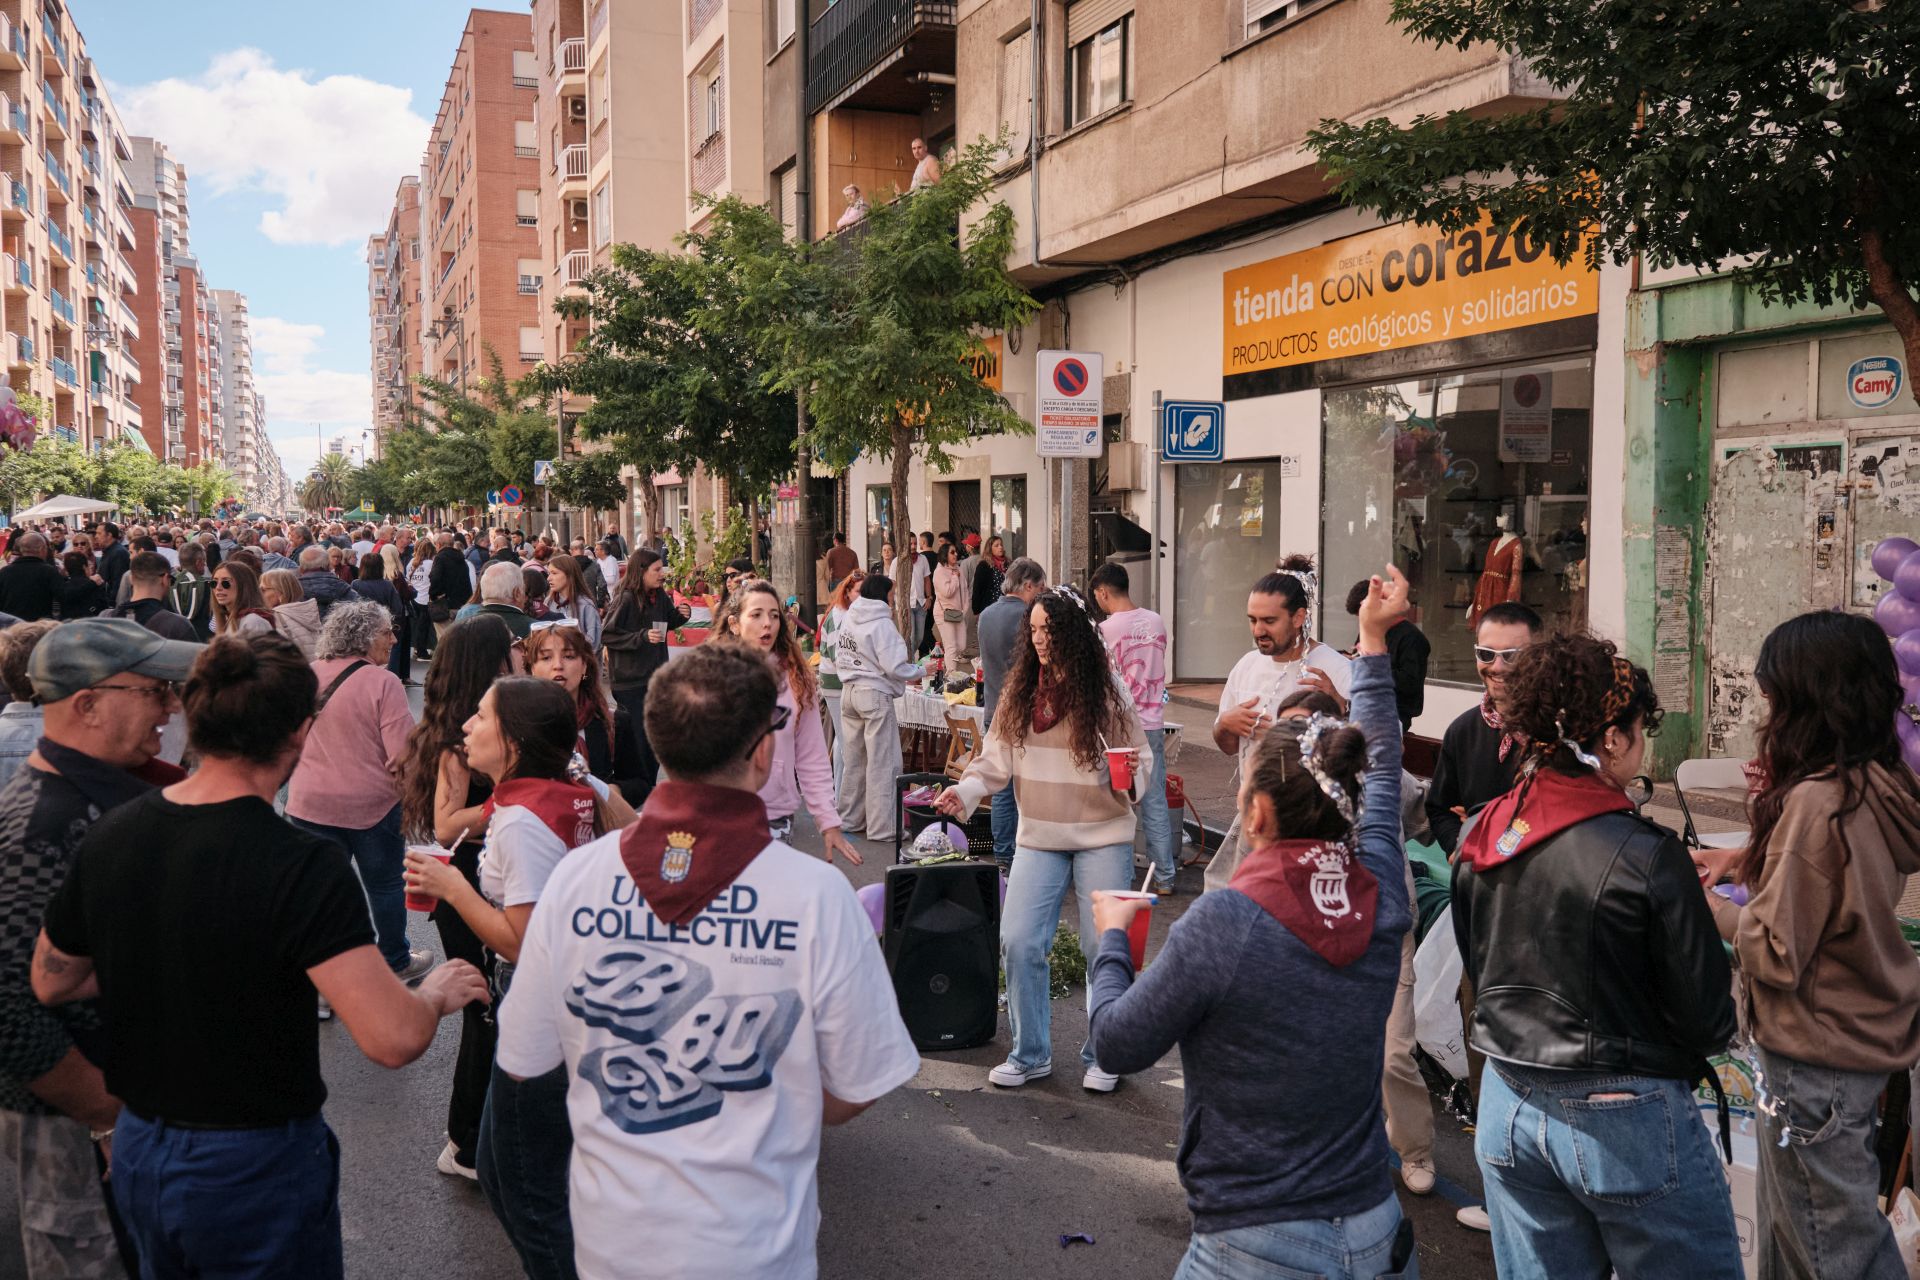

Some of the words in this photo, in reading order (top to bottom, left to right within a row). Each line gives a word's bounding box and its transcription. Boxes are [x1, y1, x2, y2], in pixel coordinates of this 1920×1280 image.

[1233, 273, 1314, 326] tienda
[1320, 268, 1374, 306] CON
[1232, 331, 1318, 366] PRODUCTOS
[1327, 309, 1432, 350] ecológicos
[1442, 303, 1456, 336] y
[1461, 279, 1579, 326] solidarios
[1862, 360, 1888, 371] Nestlé
[1854, 375, 1895, 396] Camy
[573, 799, 593, 810] San
[1297, 845, 1322, 865] SAN
[611, 875, 758, 914] UED
[571, 906, 799, 951] COLLECTIVE
